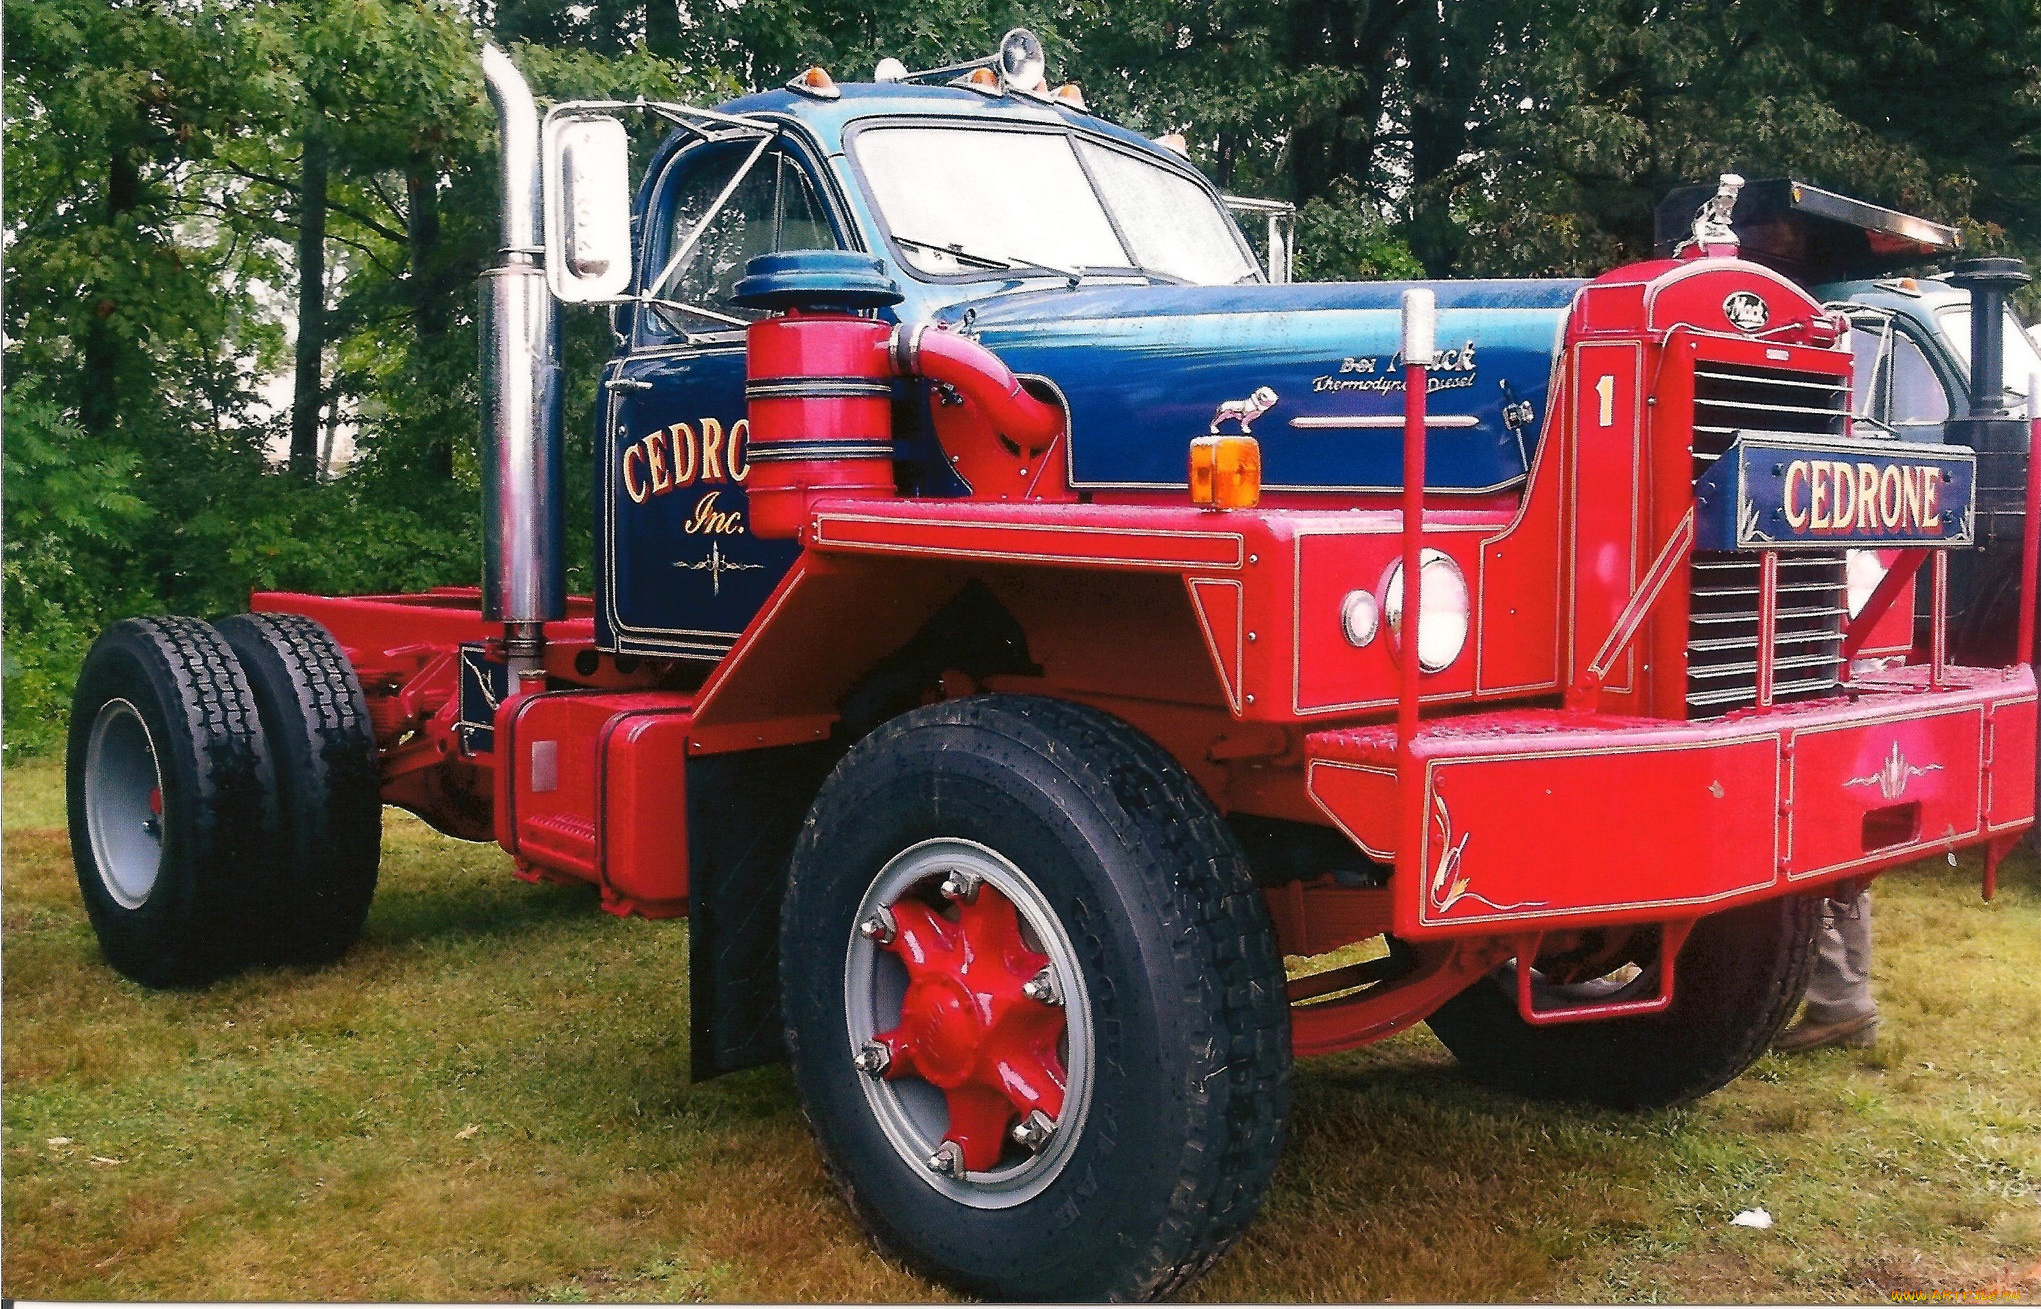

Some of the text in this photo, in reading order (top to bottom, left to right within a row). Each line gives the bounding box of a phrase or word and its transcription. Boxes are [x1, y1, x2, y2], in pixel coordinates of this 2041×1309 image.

[1387, 339, 1477, 371] ack
[1425, 372, 1476, 395] Diesel
[1595, 375, 1615, 427] 1
[684, 491, 745, 535] Inc.
[1783, 459, 1943, 534] CEDRONE
